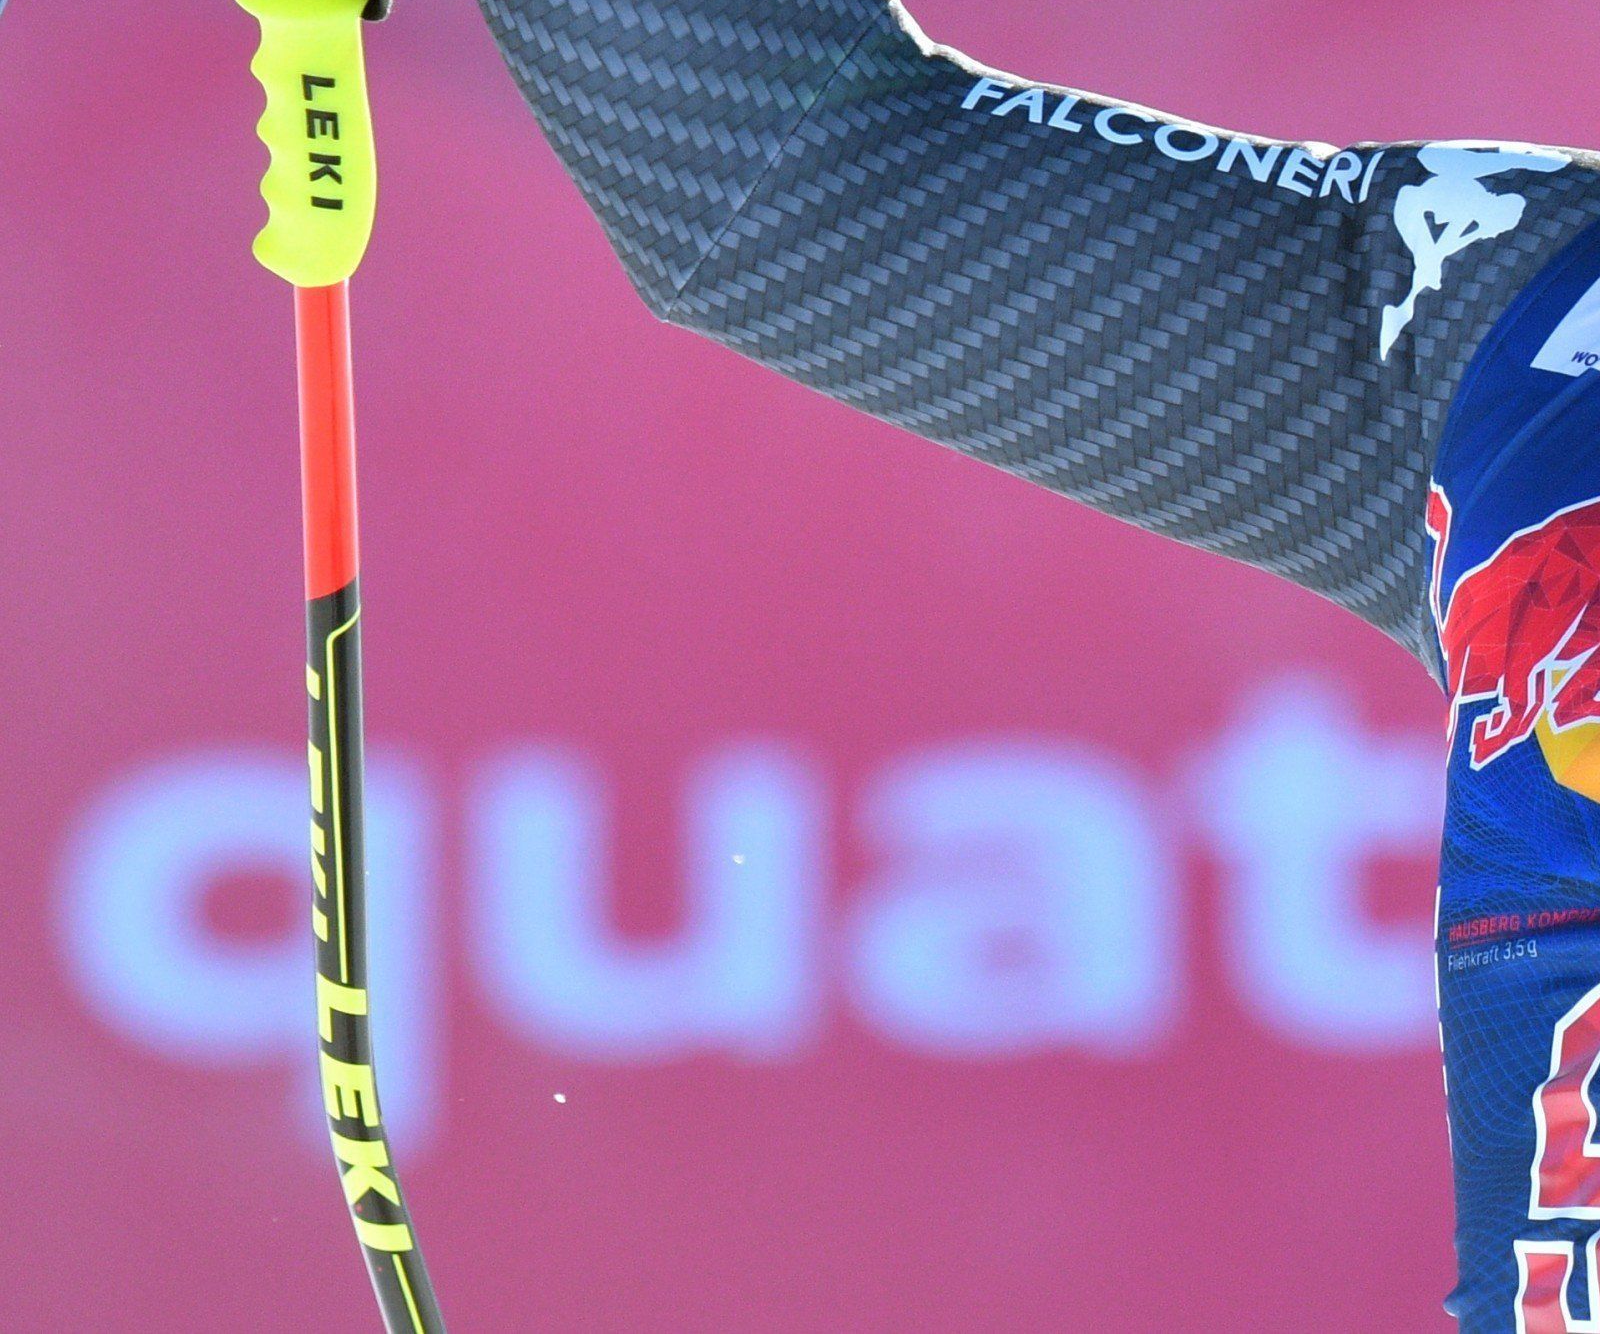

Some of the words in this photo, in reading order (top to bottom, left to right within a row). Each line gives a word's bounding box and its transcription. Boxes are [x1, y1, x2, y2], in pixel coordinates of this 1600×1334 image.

[301, 73, 344, 211] LEKI
[960, 76, 1386, 205] FALCONERI
[1448, 913, 1521, 942] HAUSBERG
[315, 971, 414, 1252] LEKI
